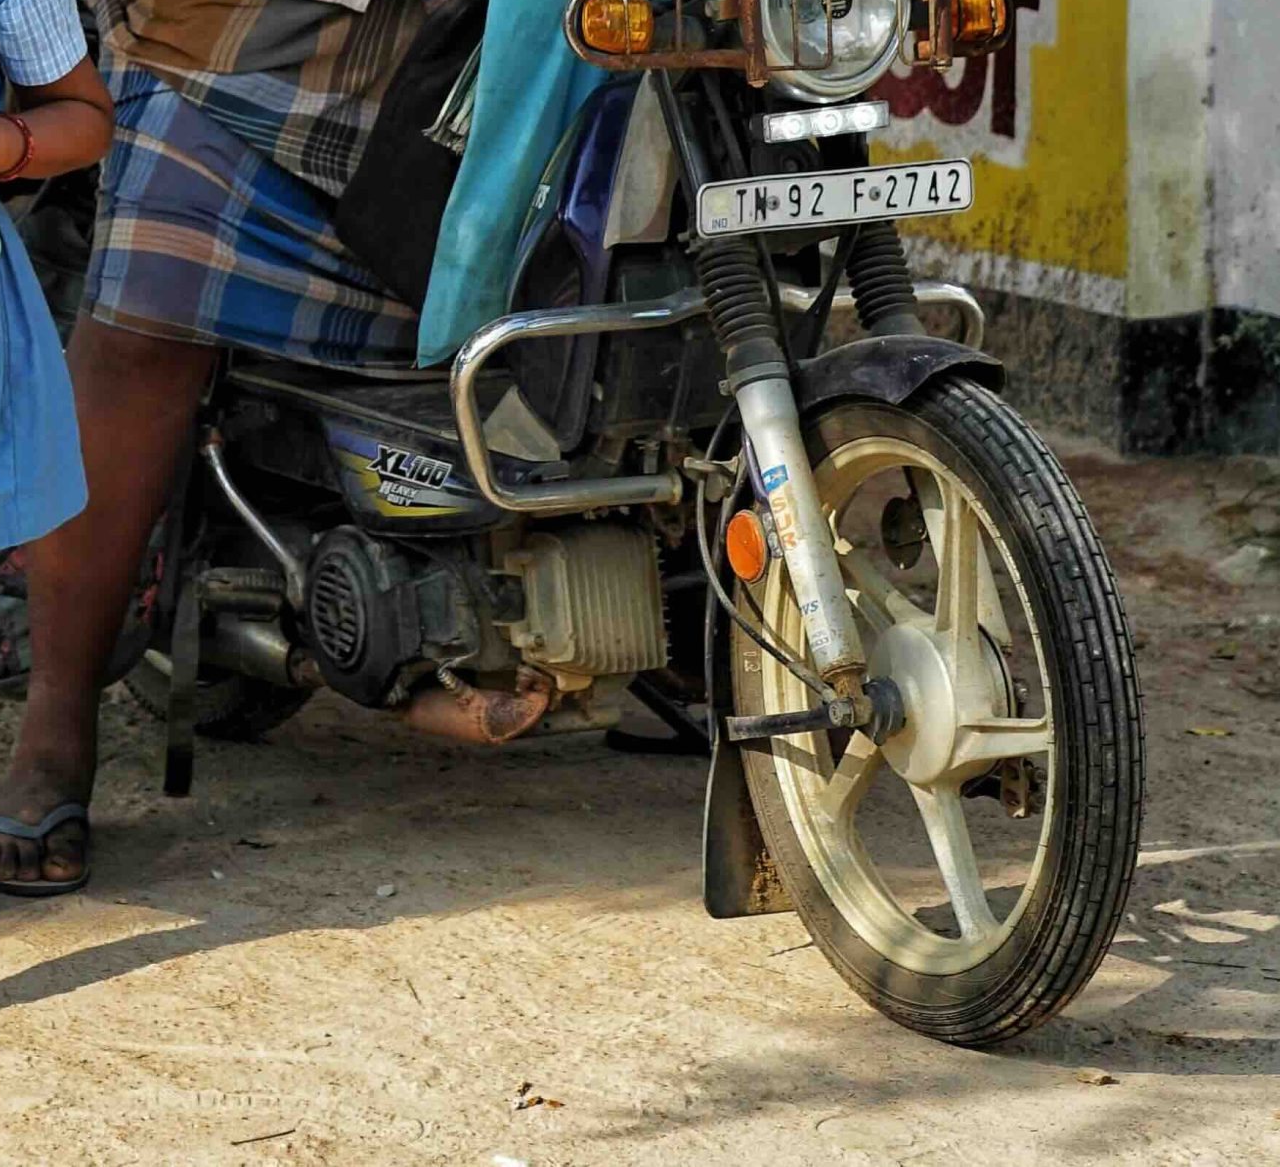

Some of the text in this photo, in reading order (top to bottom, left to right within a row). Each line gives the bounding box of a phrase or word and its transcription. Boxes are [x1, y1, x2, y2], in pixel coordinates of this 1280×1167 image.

[735, 168, 962, 224] TN 92 F 2742
[368, 445, 452, 488] XL100
[379, 480, 419, 499] HEAVY
[386, 493, 413, 507] DUTY
